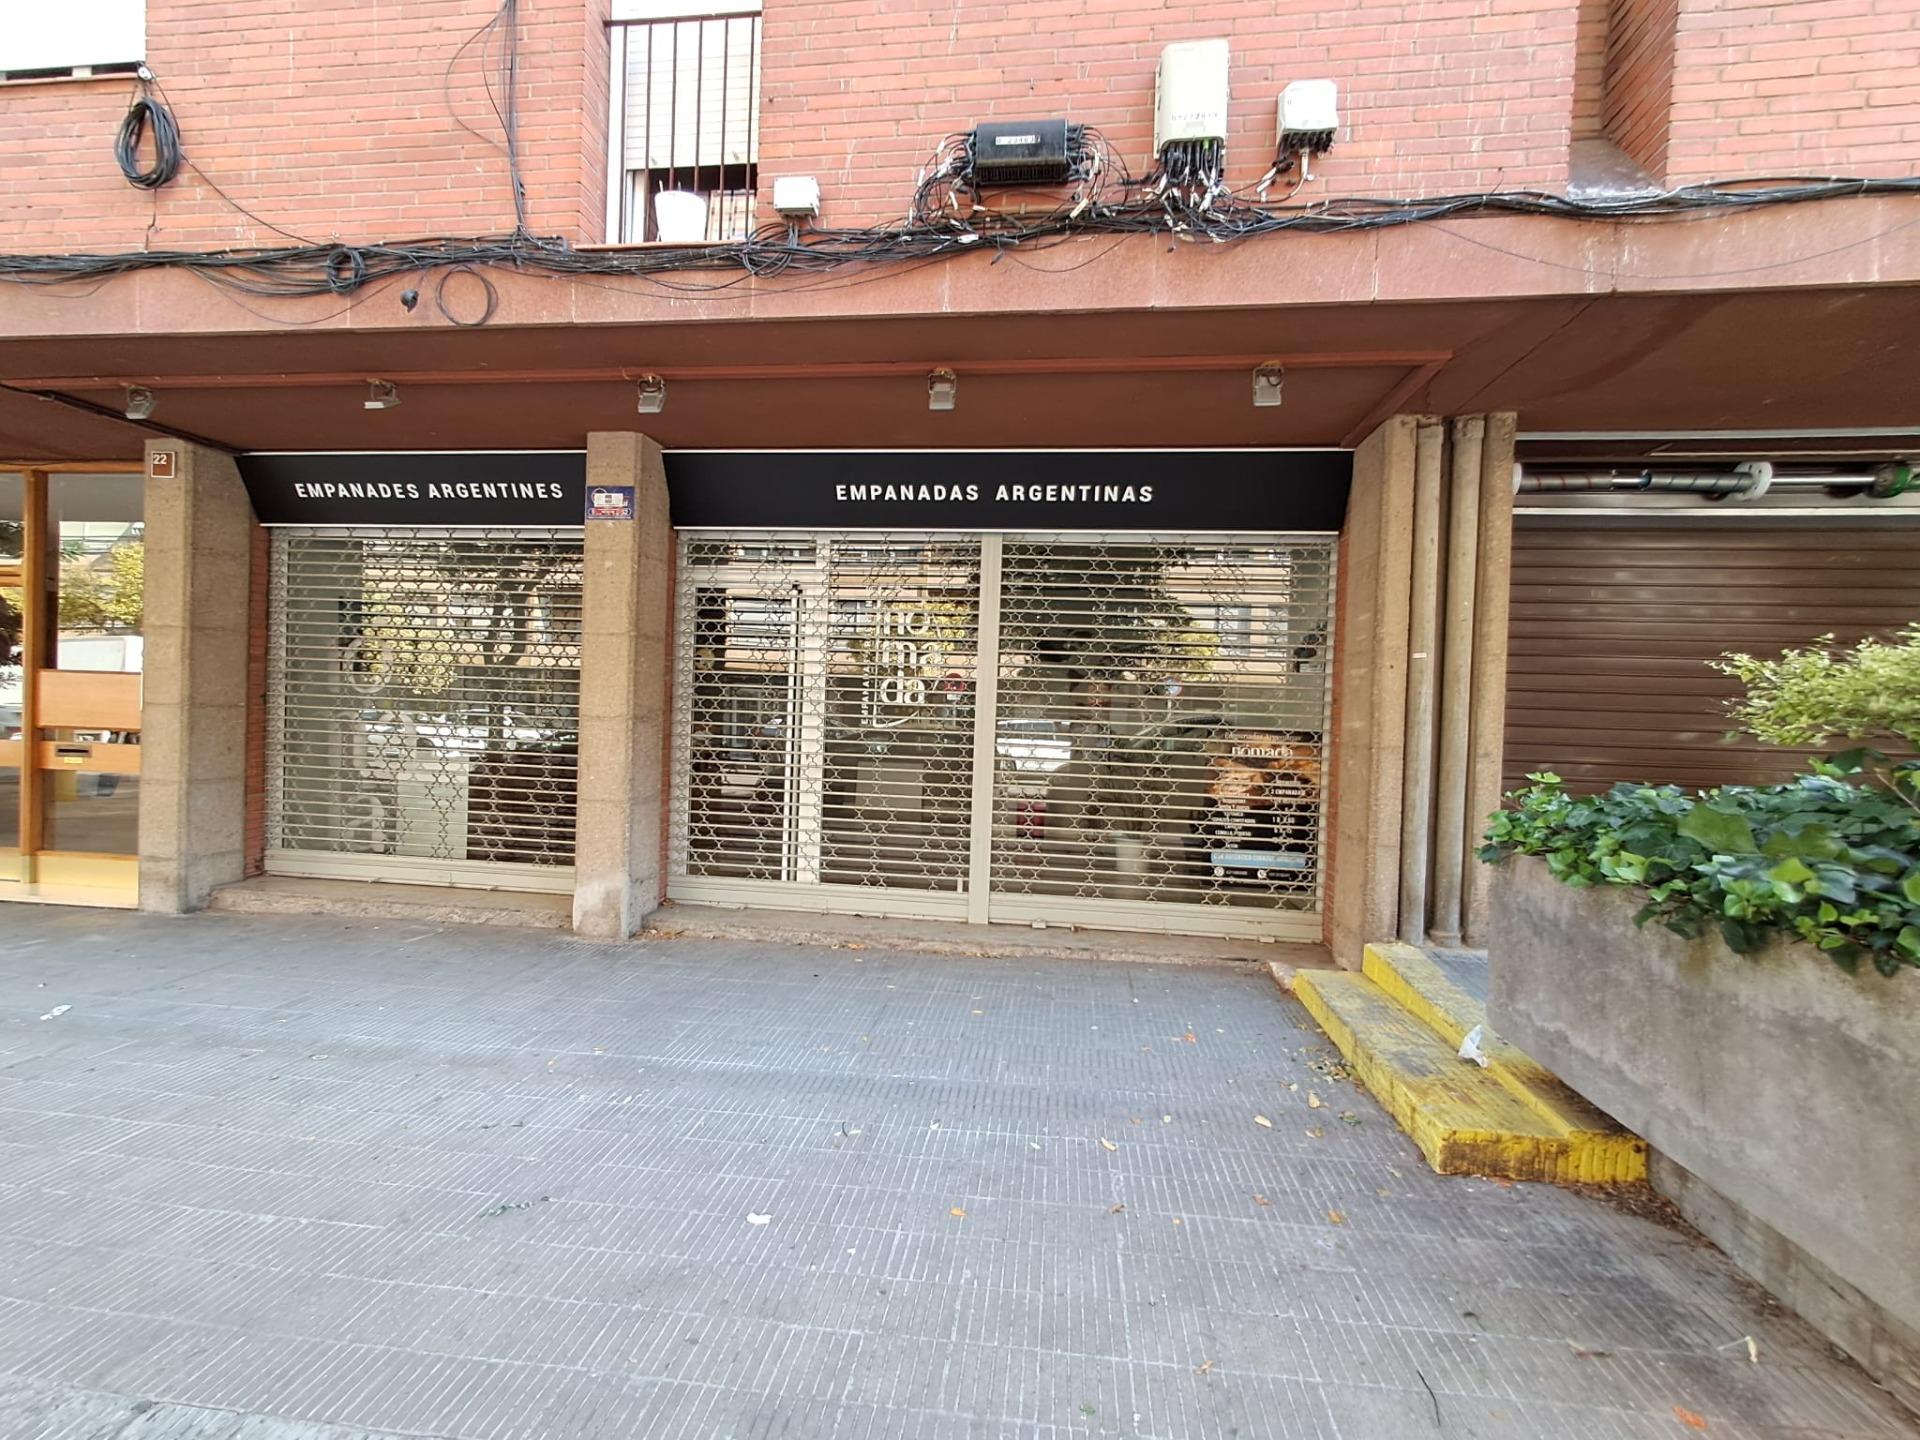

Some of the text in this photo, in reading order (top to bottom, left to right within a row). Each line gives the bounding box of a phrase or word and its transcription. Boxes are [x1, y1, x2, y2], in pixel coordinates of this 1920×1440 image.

[153, 454, 167, 465] 22
[294, 483, 563, 499] EMPANADES ARGENTINES
[835, 484, 1153, 502] EMPANADAS ARGENTINAS
